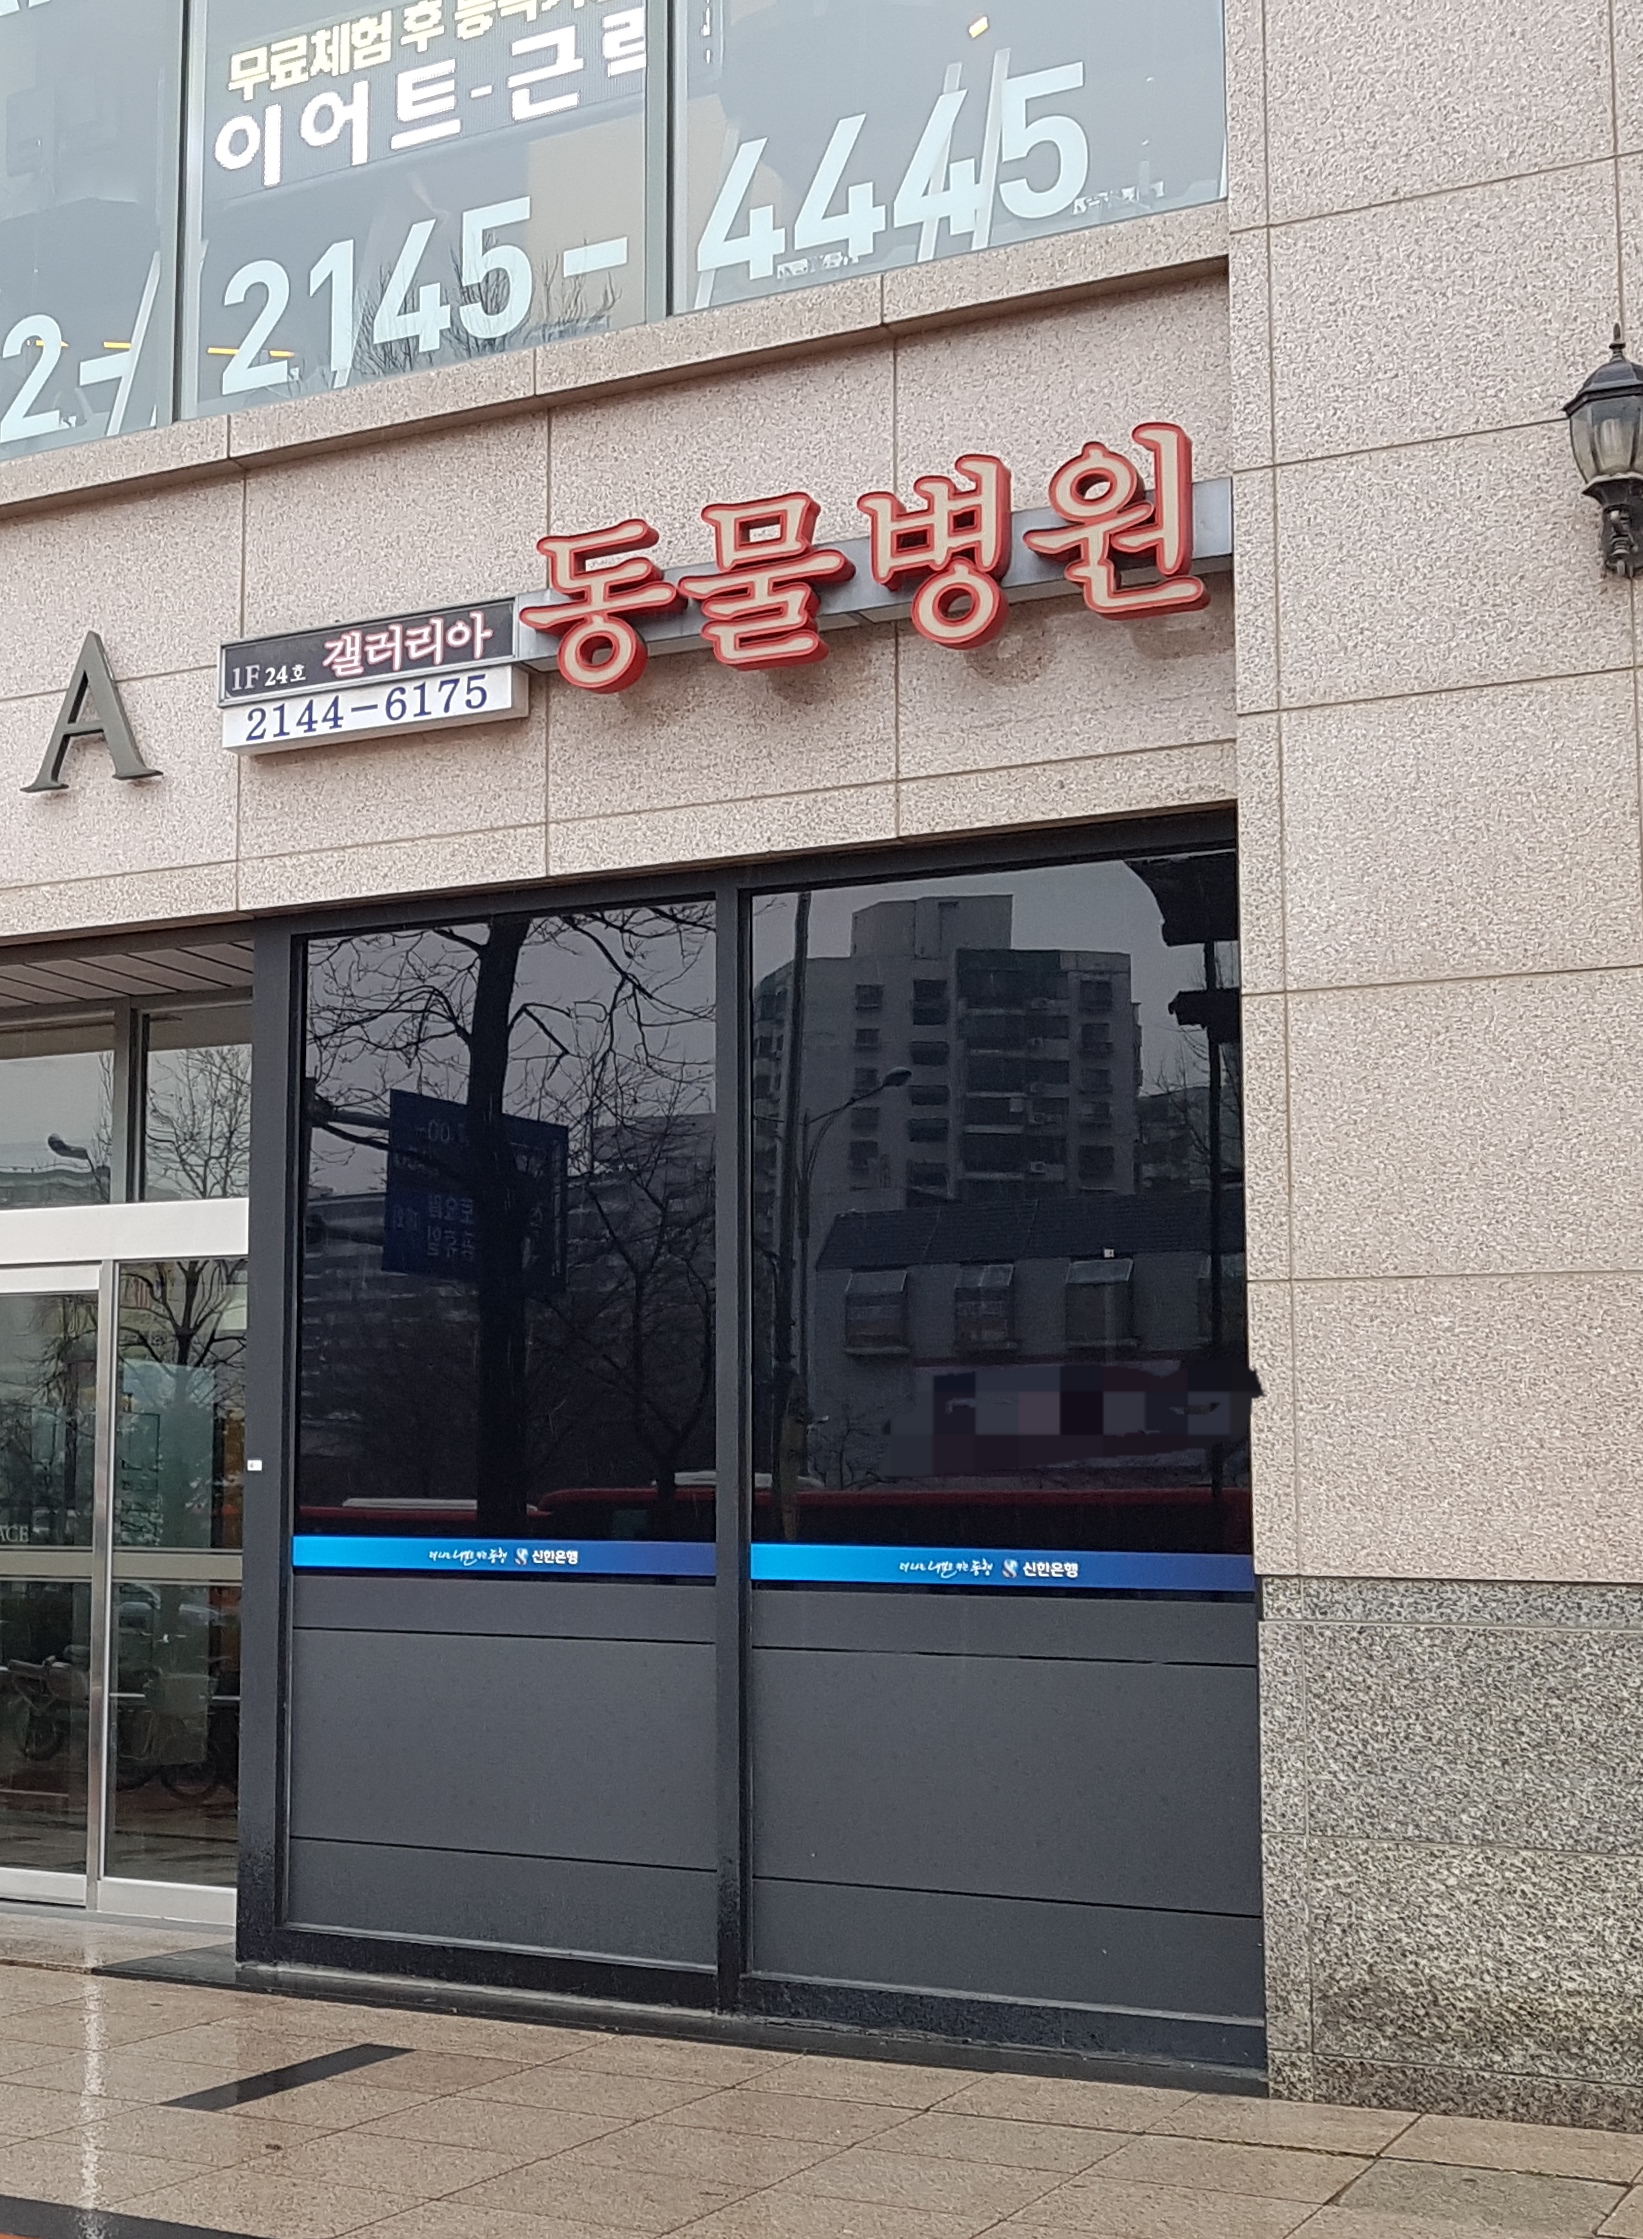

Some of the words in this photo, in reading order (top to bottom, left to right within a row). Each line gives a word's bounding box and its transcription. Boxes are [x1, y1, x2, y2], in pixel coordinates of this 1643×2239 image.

[228, 10, 393, 102] 무료체험
[400, 0, 446, 53] 후
[519, 422, 1211, 695] 동물병원
[231, 664, 261, 691] 1F
[264, 663, 307, 687] 24호
[322, 610, 494, 678] 갤러리아
[20, 630, 164, 793] A
[245, 673, 488, 742] 2144-6175
[531, 1549, 579, 1565] 신한은행
[1022, 1561, 1079, 1579] 신한은행
